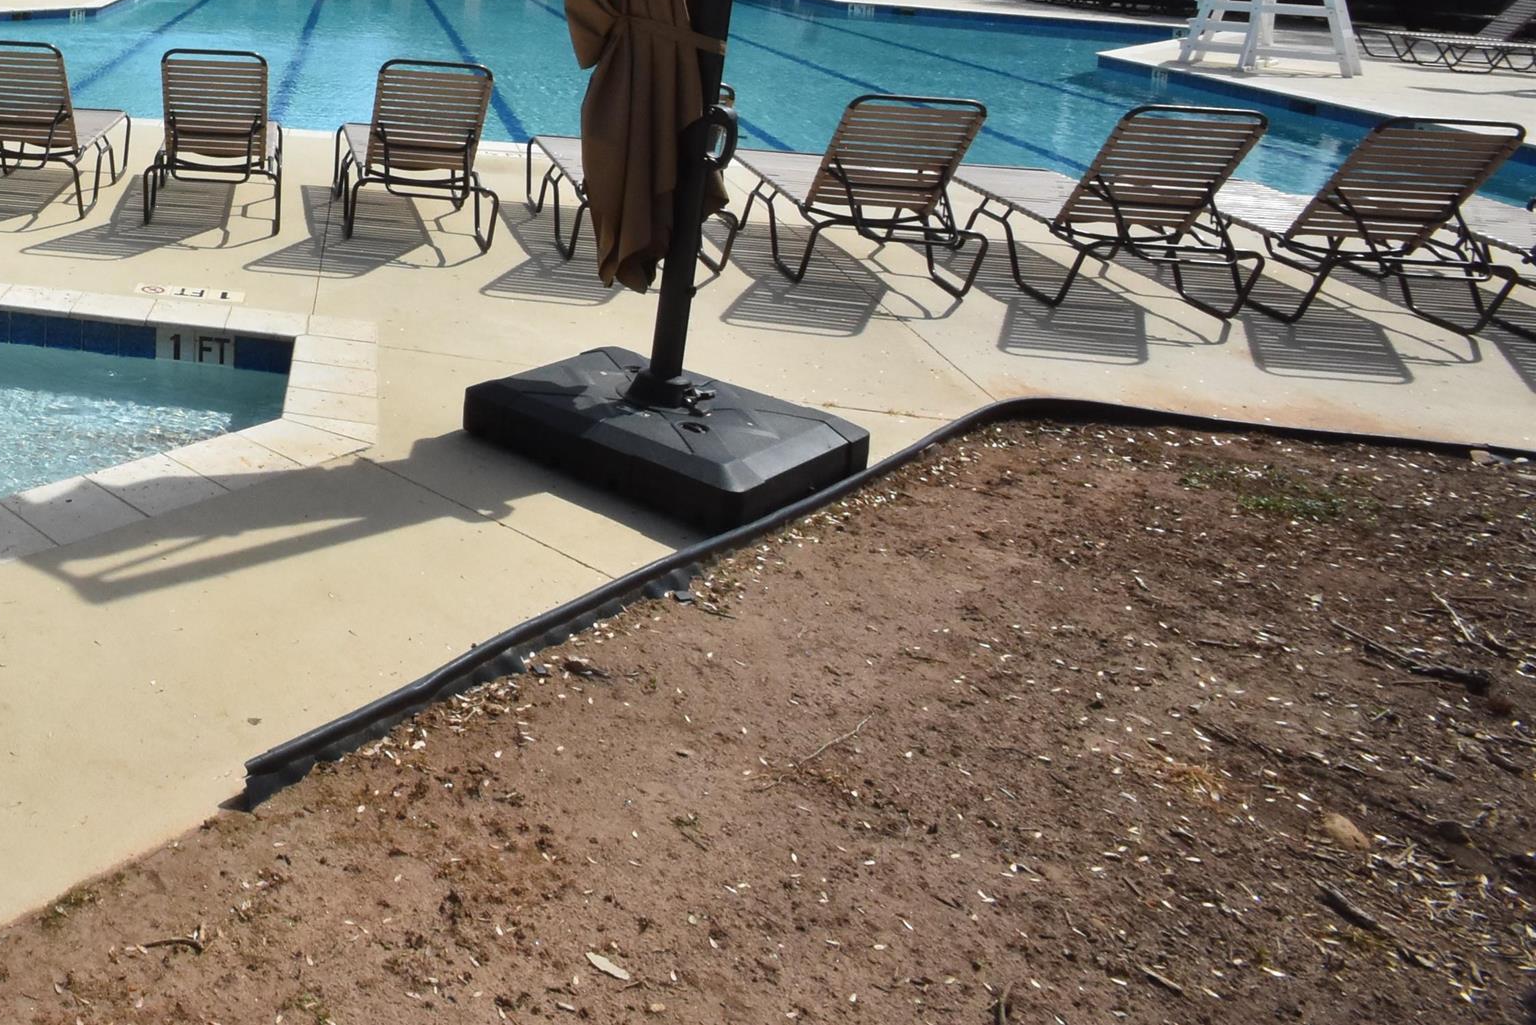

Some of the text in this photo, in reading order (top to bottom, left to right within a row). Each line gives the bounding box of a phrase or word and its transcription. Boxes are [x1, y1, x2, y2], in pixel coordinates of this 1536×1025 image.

[174, 287, 231, 300] 1 FT
[169, 333, 231, 365] 1 FT
